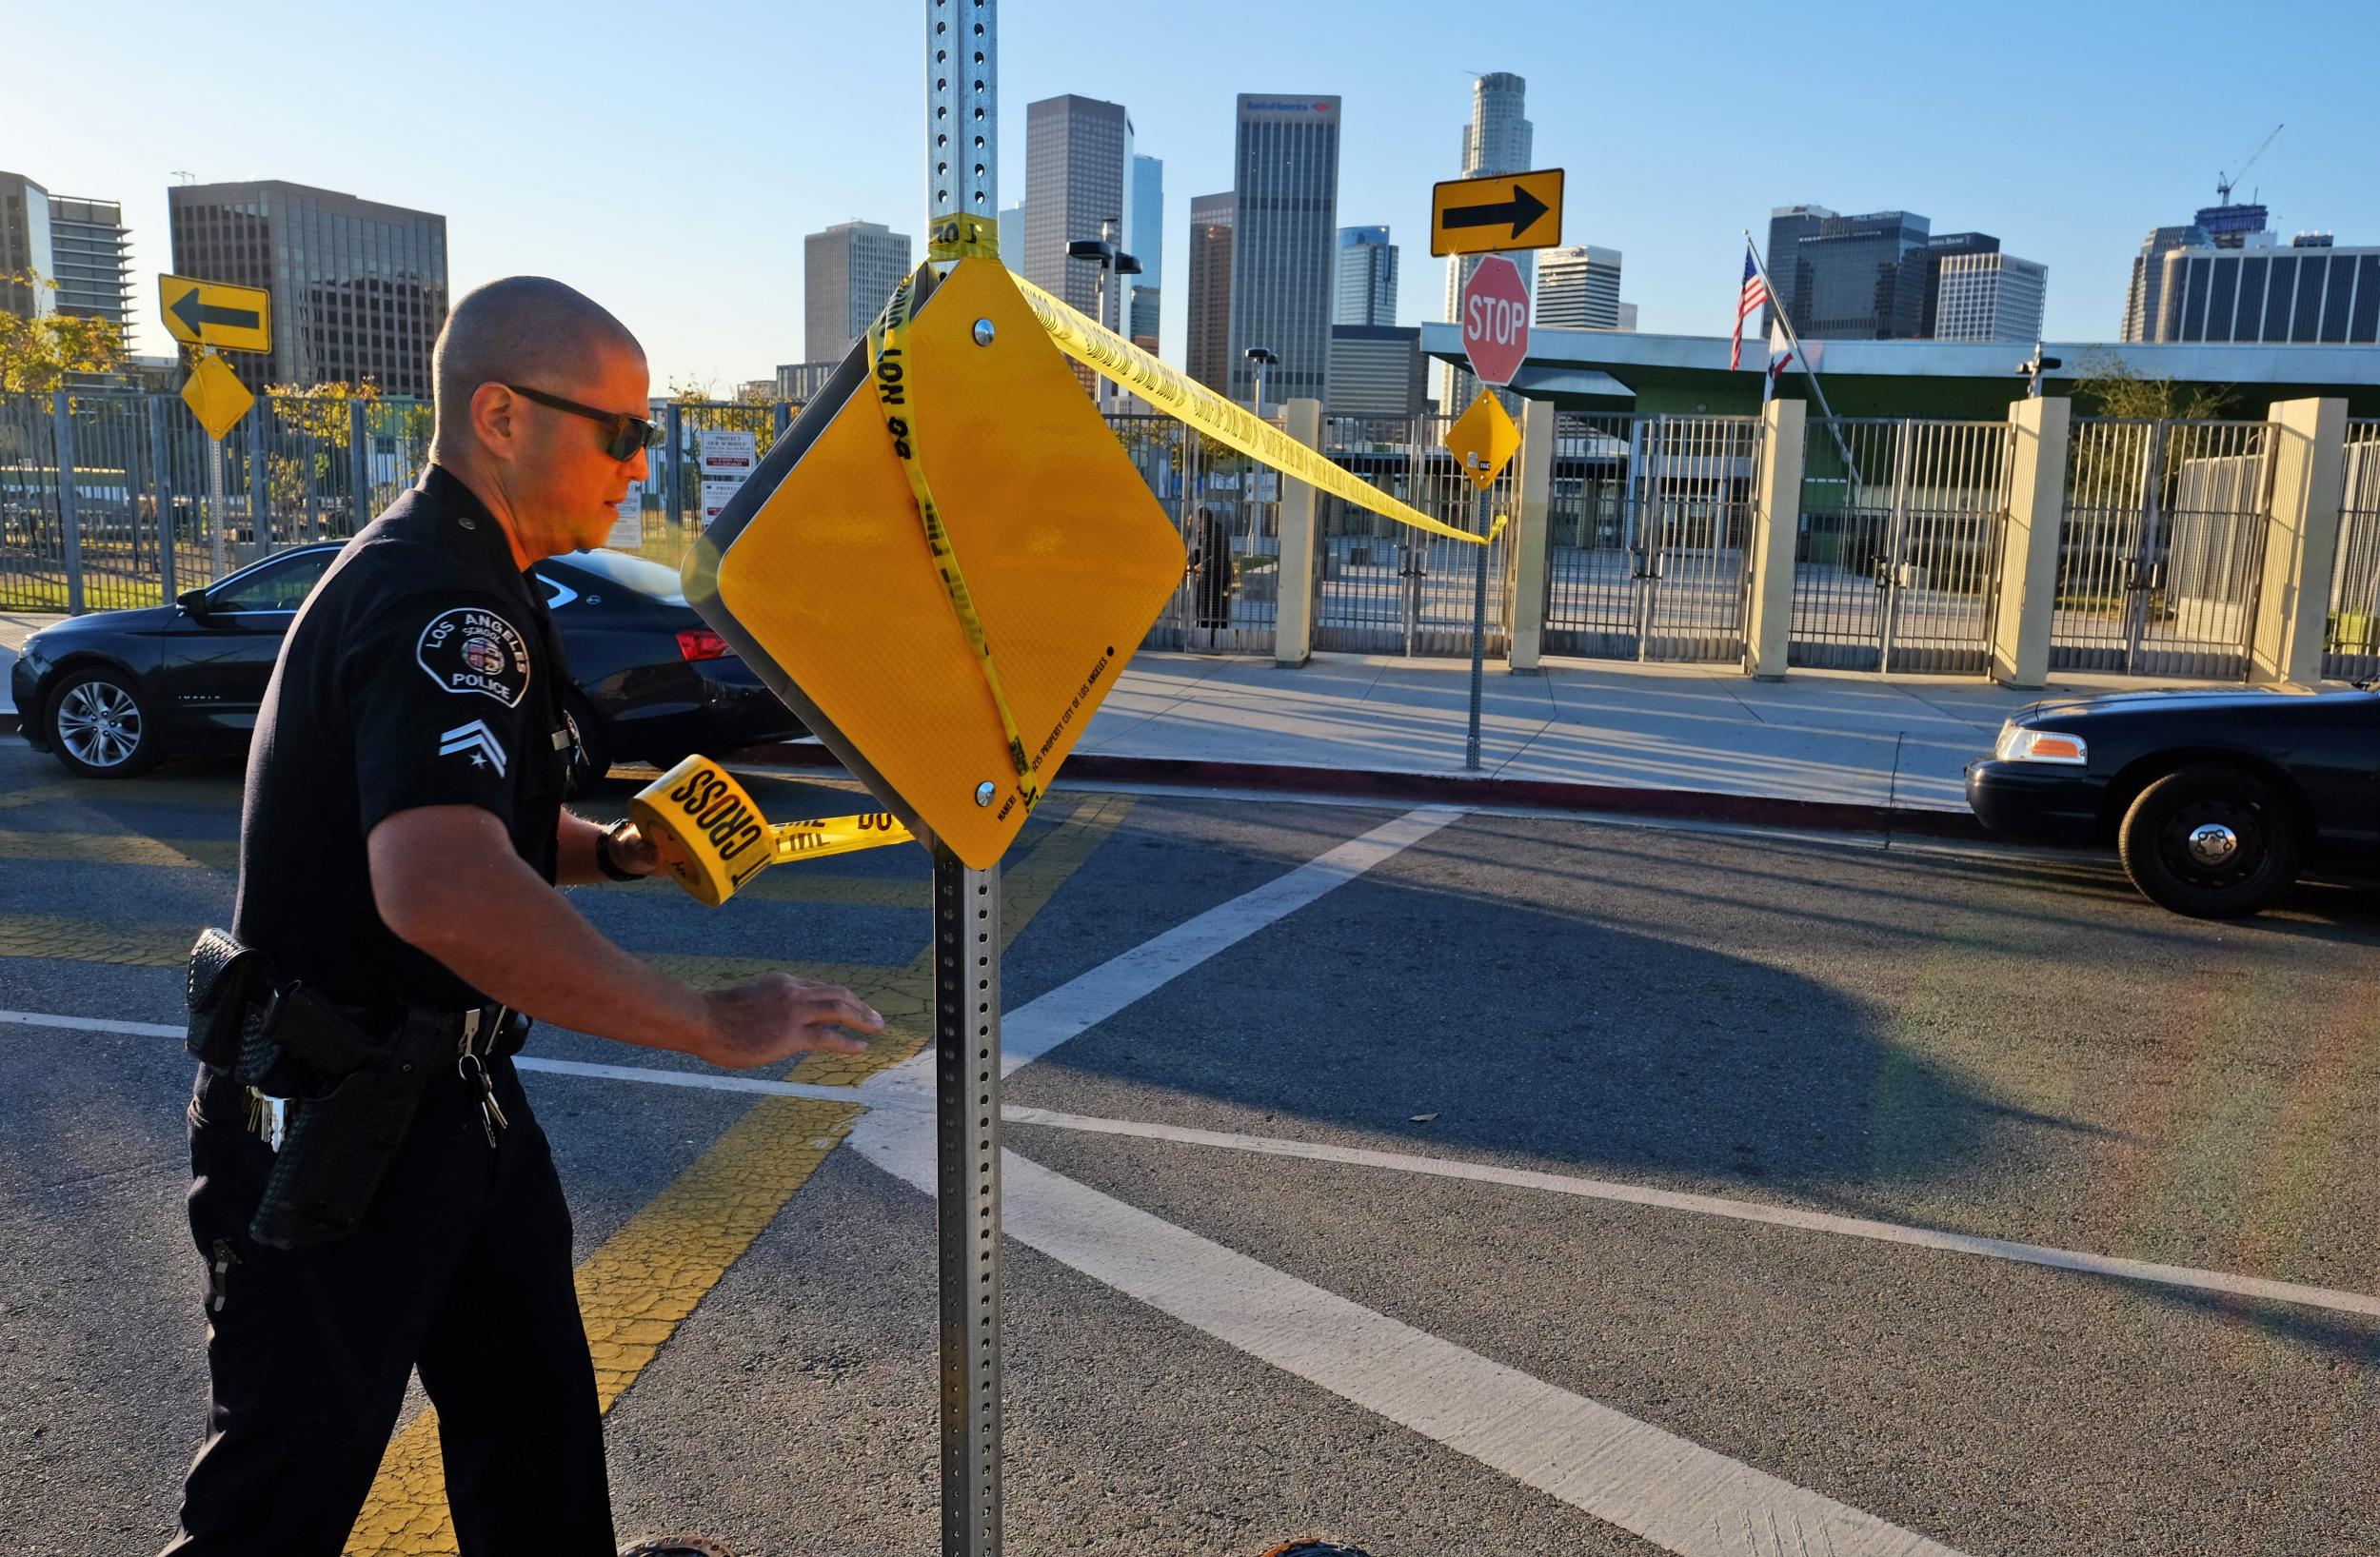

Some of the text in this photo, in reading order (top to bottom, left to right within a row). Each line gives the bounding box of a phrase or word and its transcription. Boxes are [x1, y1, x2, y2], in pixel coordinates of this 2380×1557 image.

[1468, 294, 1525, 346] STOP
[425, 613, 526, 674] LOS ANGELES
[462, 626, 502, 644] SCHOOL
[452, 673, 511, 700] POLICE
[1042, 723, 1064, 757] PROPERTY
[1061, 708, 1075, 725] CITY
[1072, 698, 1081, 709] OF
[1081, 685, 1090, 700] LOS
[1089, 657, 1108, 687] ANGELES
[670, 769, 762, 861] CROSS
